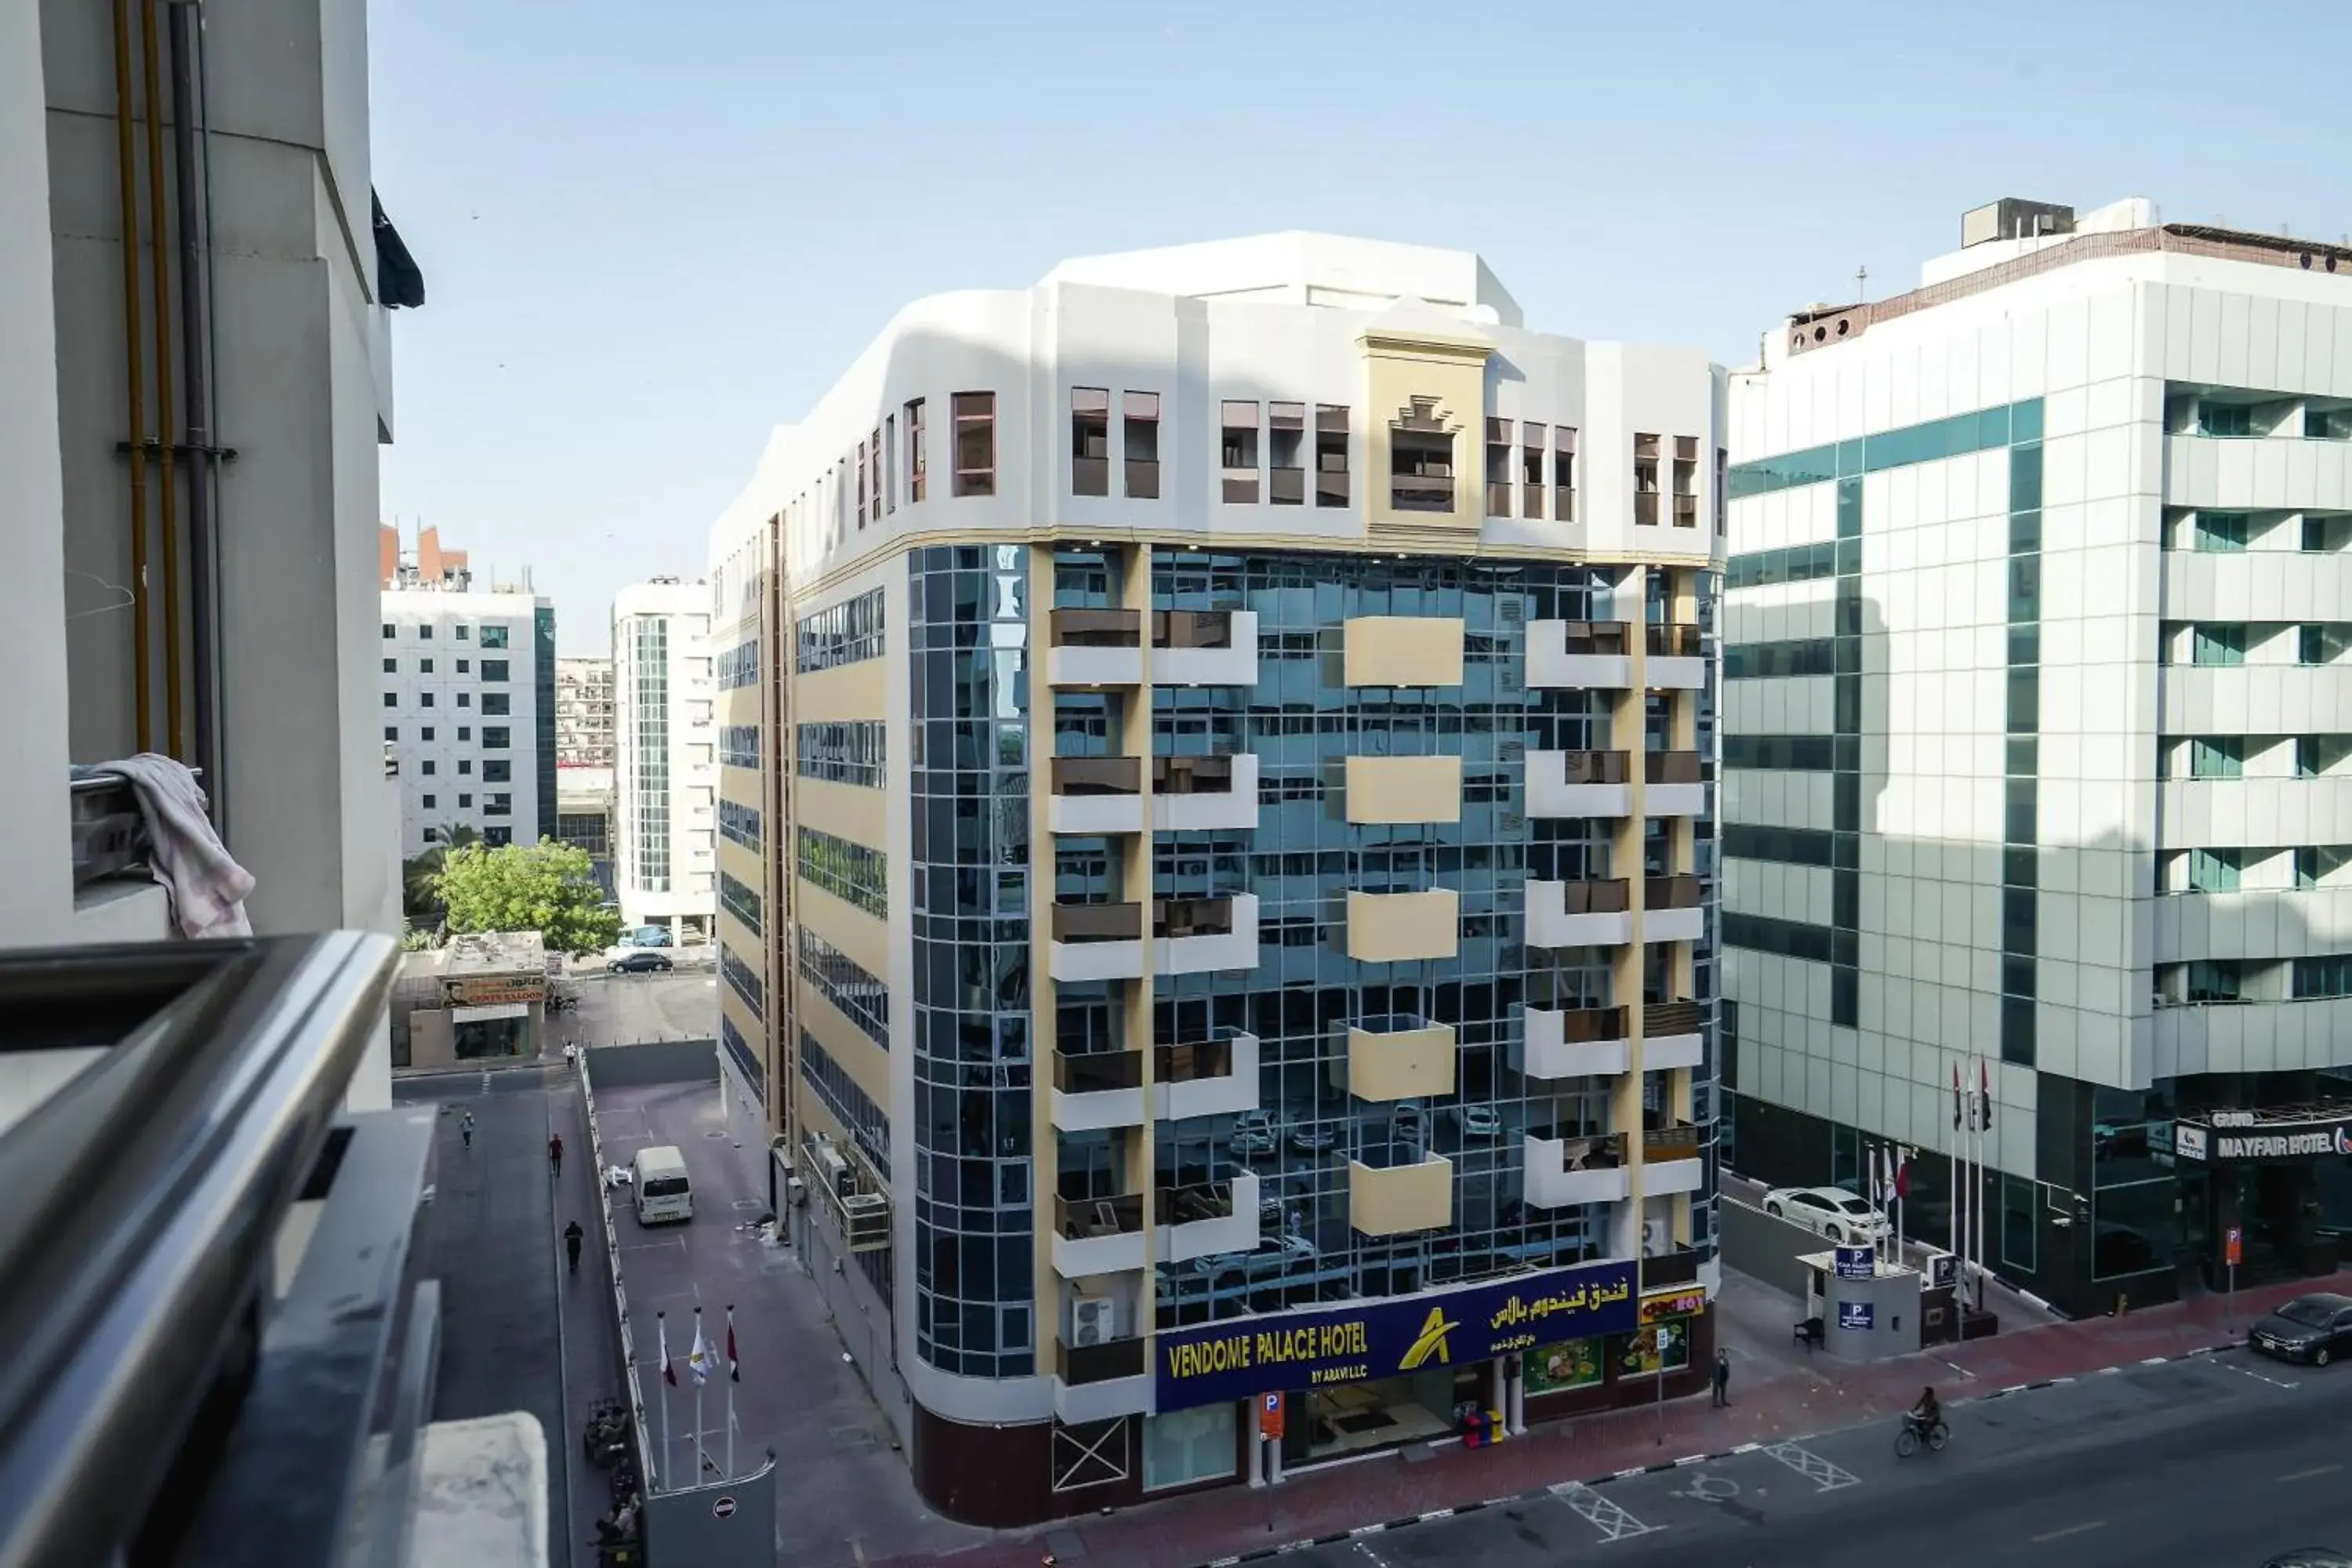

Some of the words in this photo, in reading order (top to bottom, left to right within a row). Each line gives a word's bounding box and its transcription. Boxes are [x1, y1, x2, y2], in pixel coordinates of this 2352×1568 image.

[504, 992, 544, 1000] SALOON
[2212, 1112, 2254, 1127] GRAND
[2217, 1135, 2288, 1158] MAYFAIR
[2288, 1132, 2333, 1155] HOTEL
[2230, 1230, 2237, 1243] P
[1854, 1250, 1864, 1262] P
[1940, 1261, 1949, 1276] P
[1588, 1276, 1629, 1311] فندق
[1529, 1283, 1586, 1321] فيندوم
[1490, 1295, 1528, 1330] بالاس
[1853, 1305, 1862, 1316] P
[1169, 1336, 1250, 1378] VENDOME
[1257, 1327, 1316, 1364] PALACE
[1320, 1322, 1367, 1356] HOTEL
[1311, 1370, 1323, 1384] BY
[1266, 1395, 1278, 1411] P
